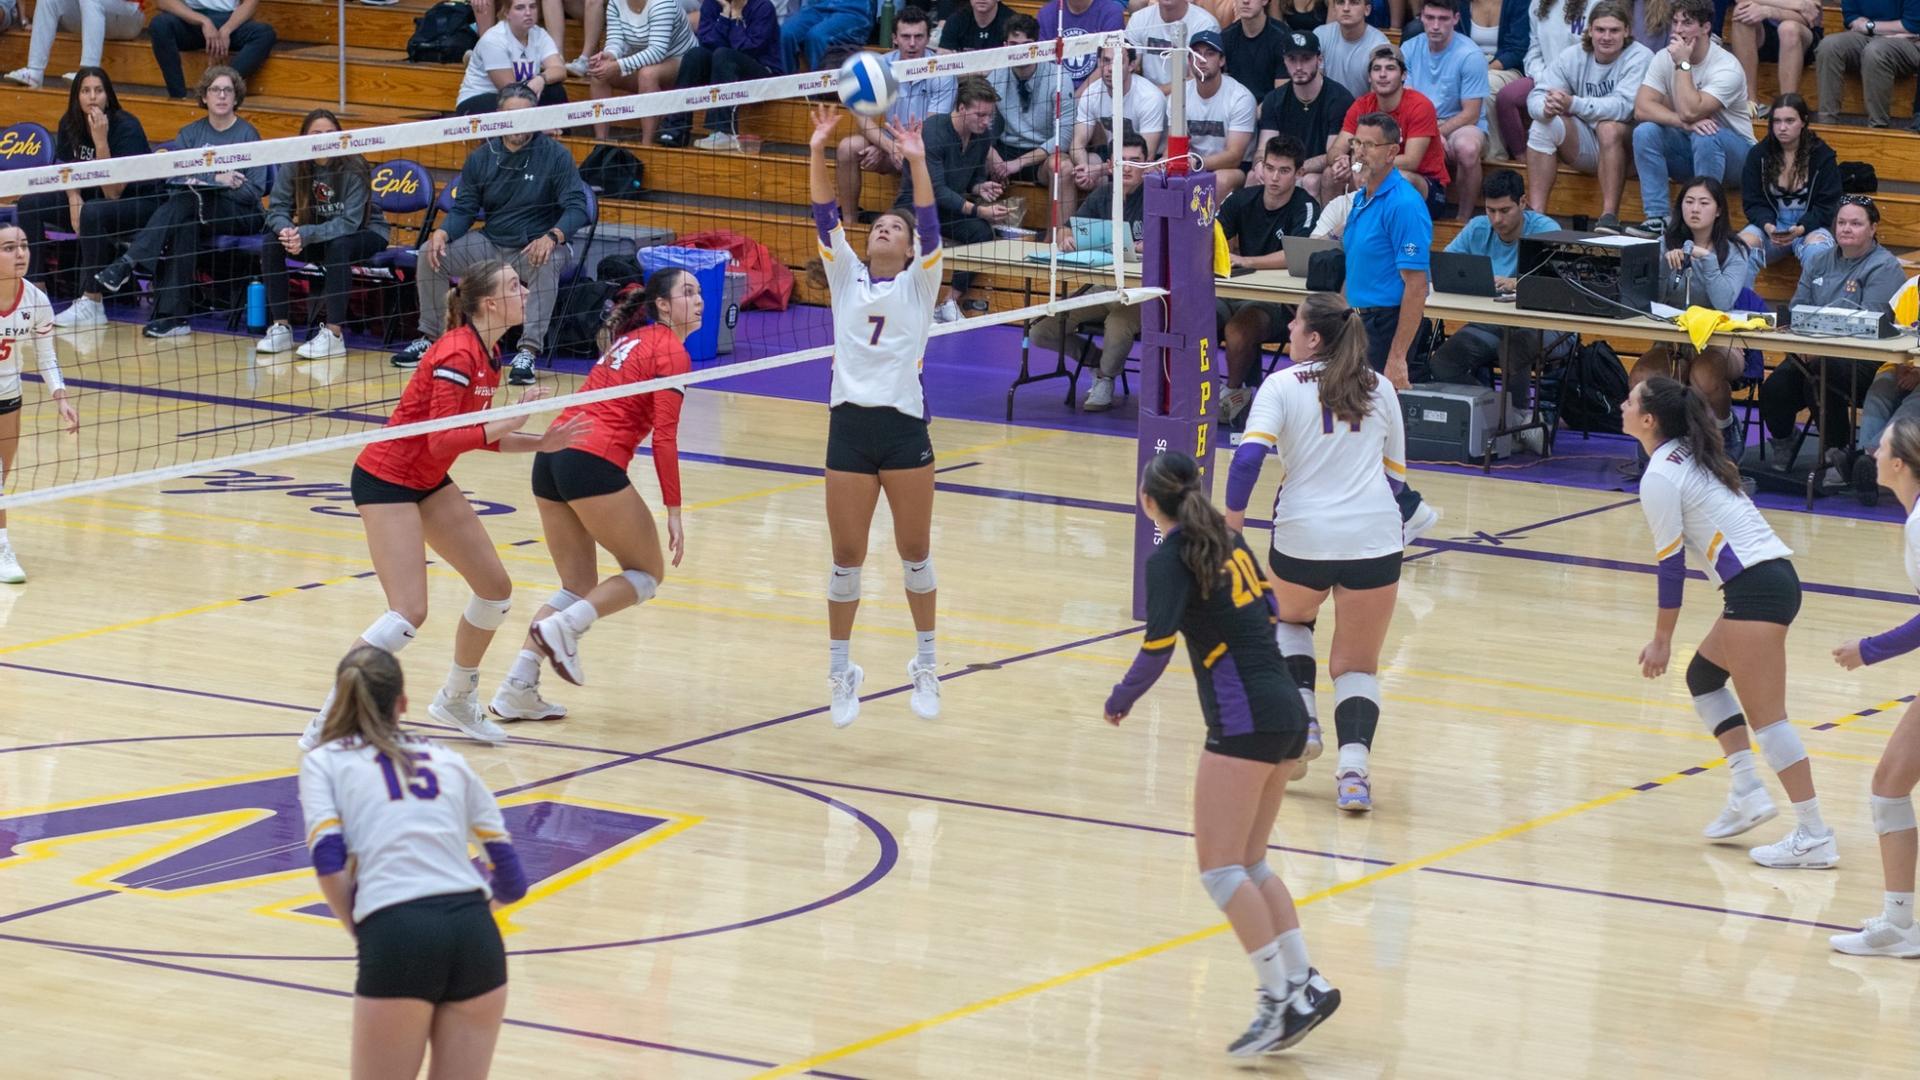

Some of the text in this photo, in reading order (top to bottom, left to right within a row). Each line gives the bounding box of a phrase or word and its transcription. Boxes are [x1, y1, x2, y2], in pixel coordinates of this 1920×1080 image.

[1007, 51, 1030, 61] WILLIAMS
[512, 61, 535, 82] W
[905, 61, 964, 76] WILLIAMS VOLLEYBALL
[798, 80, 823, 91] WILLIAMS
[685, 89, 750, 105] WILLIAMS VOLLEYBALL
[567, 105, 635, 120] WILLIAMS VOLLEYBALL
[443, 120, 514, 136] WILLIAMS VOLLEYBALL
[0, 130, 42, 160] Ephs
[311, 136, 386, 152] WILLIAMS VOLLEYBALL
[173, 153, 252, 169] WILLIAMS VOLLEYBALL
[28, 169, 111, 187] WILLIAMS VOLLEYBALL
[370, 167, 419, 198] Ephs
[867, 314, 886, 346] 7
[1195, 337, 1211, 476] EPH
[1222, 547, 1263, 609] 20
[373, 751, 441, 802] 15
